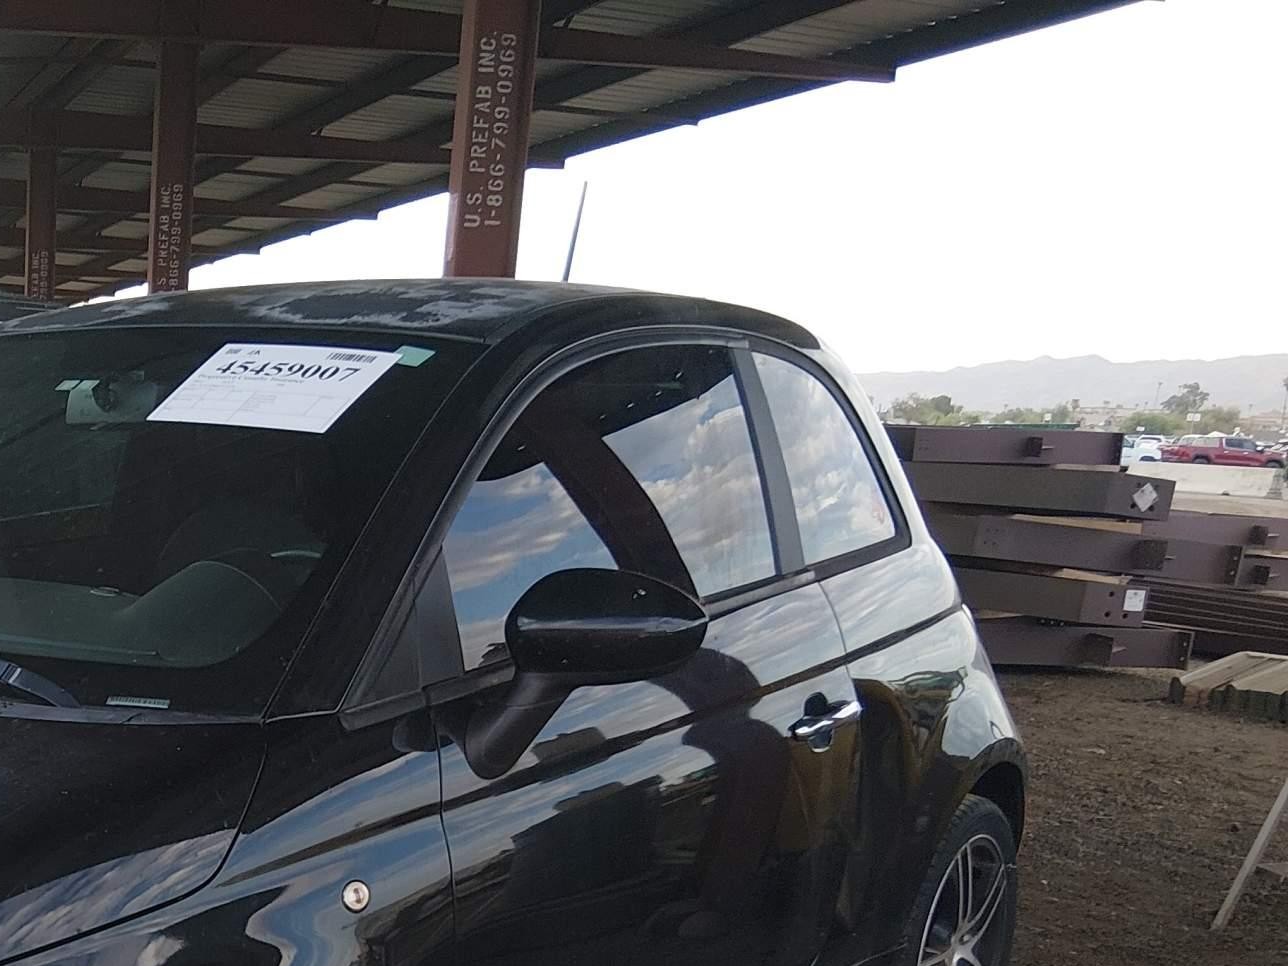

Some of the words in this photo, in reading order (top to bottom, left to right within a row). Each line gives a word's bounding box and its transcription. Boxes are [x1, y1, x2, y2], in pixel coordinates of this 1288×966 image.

[477, 31, 498, 73] INC.
[469, 85, 492, 173] PREFAB
[484, 33, 517, 226] 1-866-799-0969
[463, 187, 483, 228] U.S.
[158, 215, 170, 266] PREFAB
[169, 184, 184, 290] -866-799-0969
[216, 359, 361, 382] 45459007
